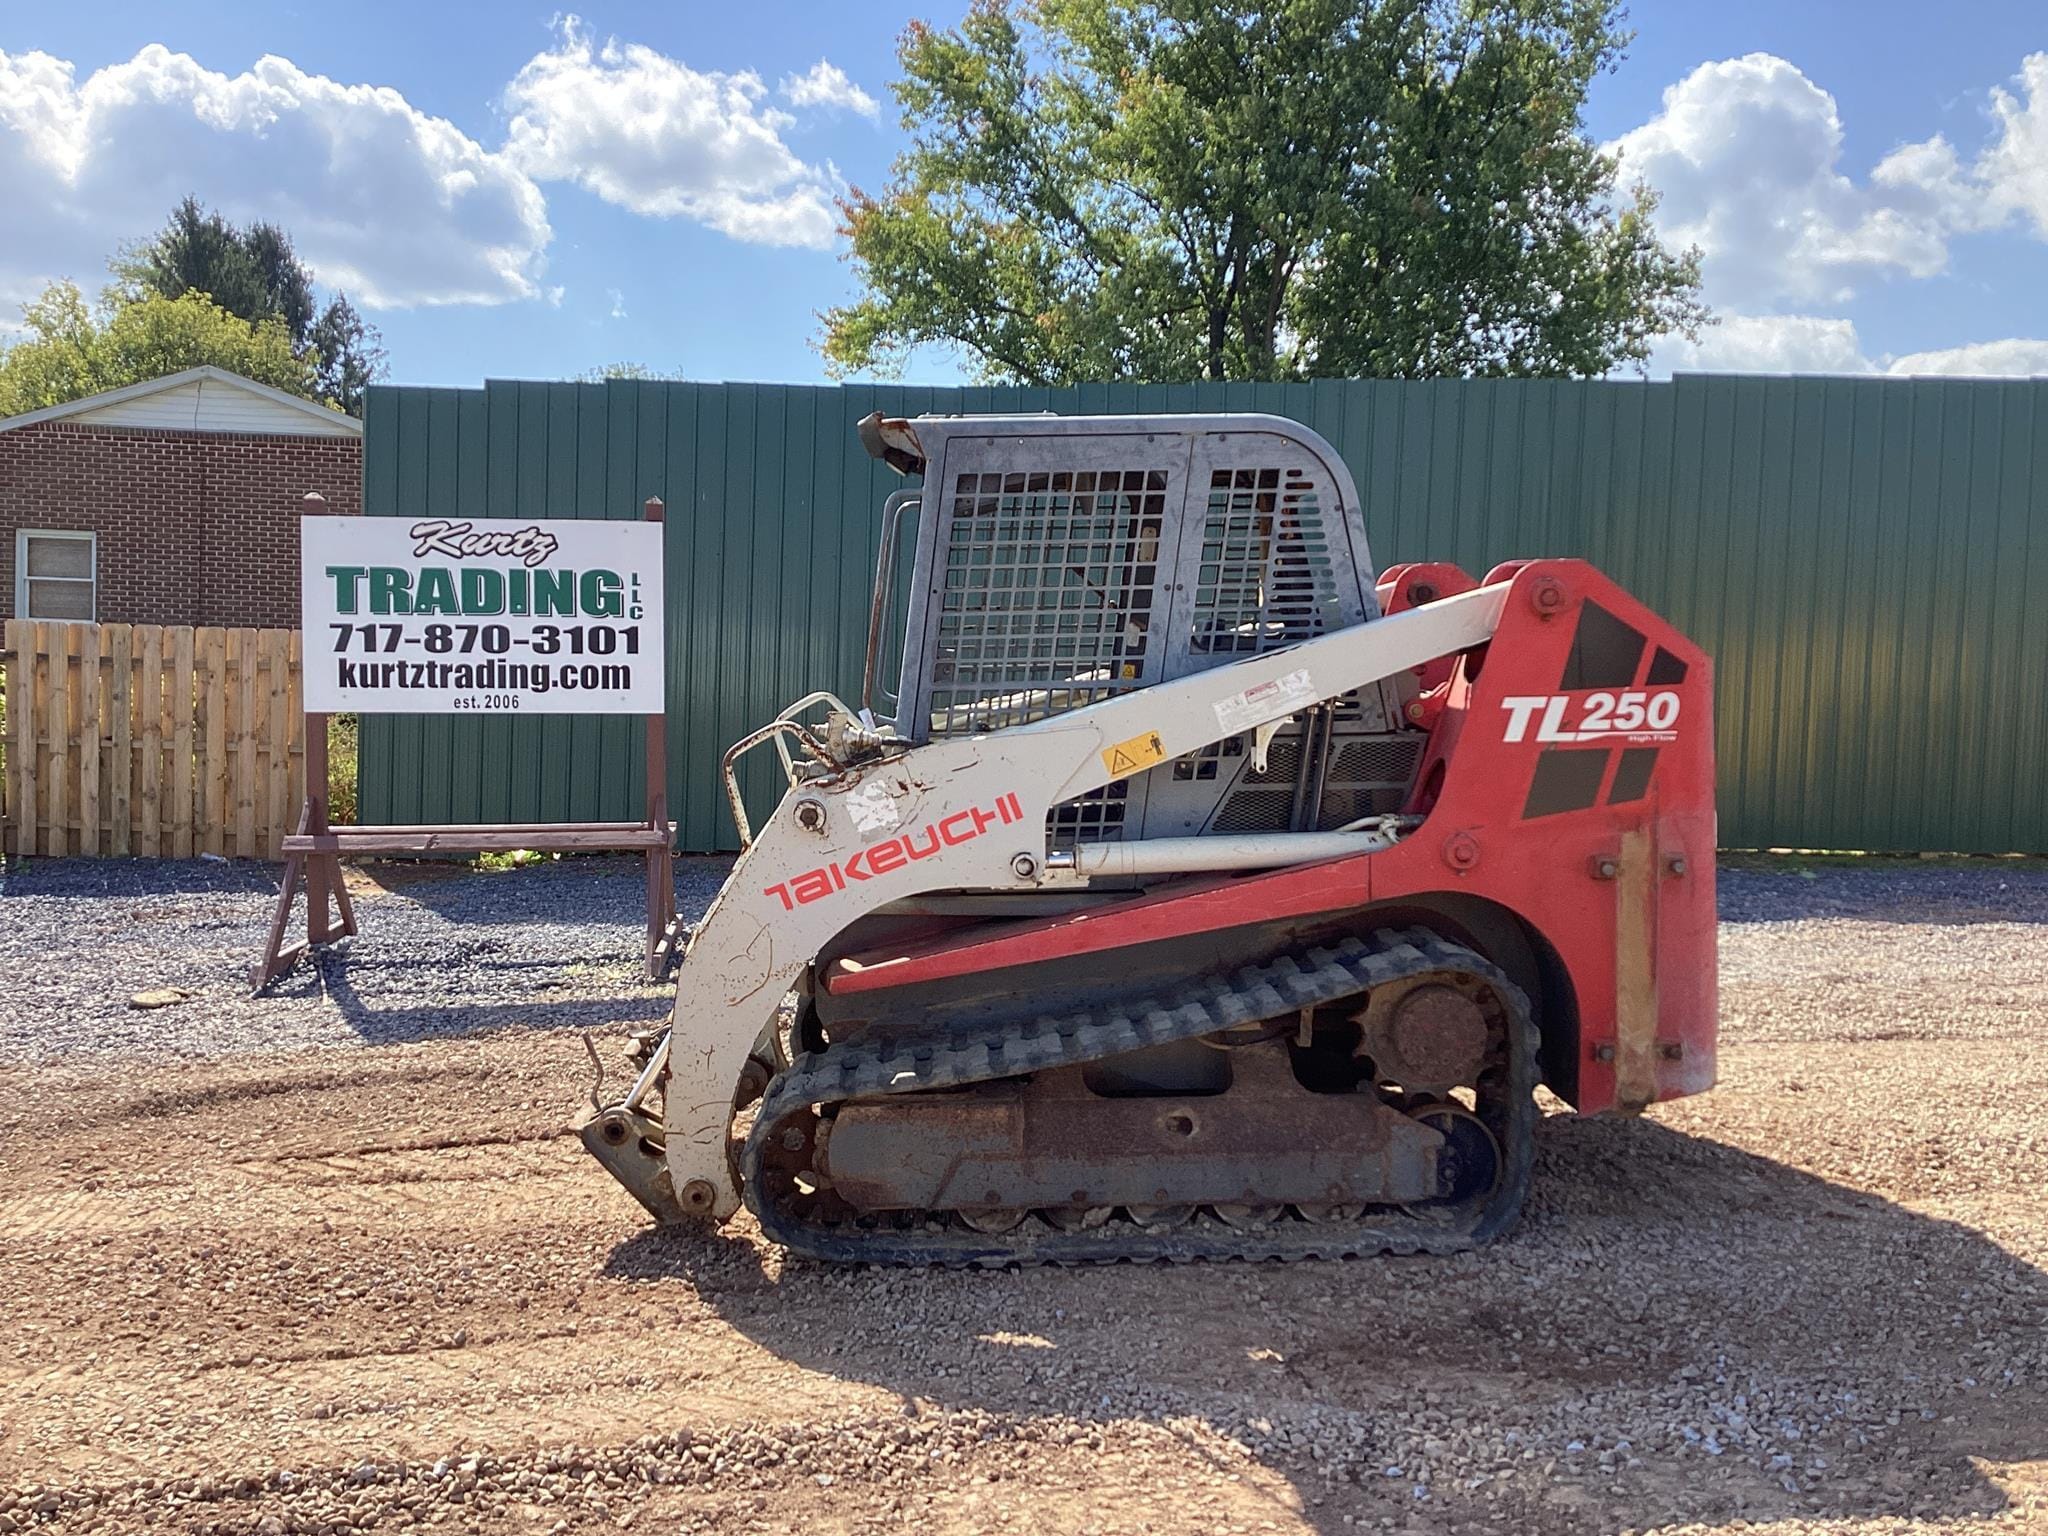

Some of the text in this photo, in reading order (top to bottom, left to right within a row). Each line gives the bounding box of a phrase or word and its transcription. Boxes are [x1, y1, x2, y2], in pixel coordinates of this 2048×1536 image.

[409, 520, 558, 567] Kurtz
[325, 565, 625, 619] TRADING
[629, 572, 644, 620] LLC
[329, 623, 639, 654] 717-870-3101
[338, 658, 631, 693] kurtztrading.com
[453, 695, 519, 709] est. 2006
